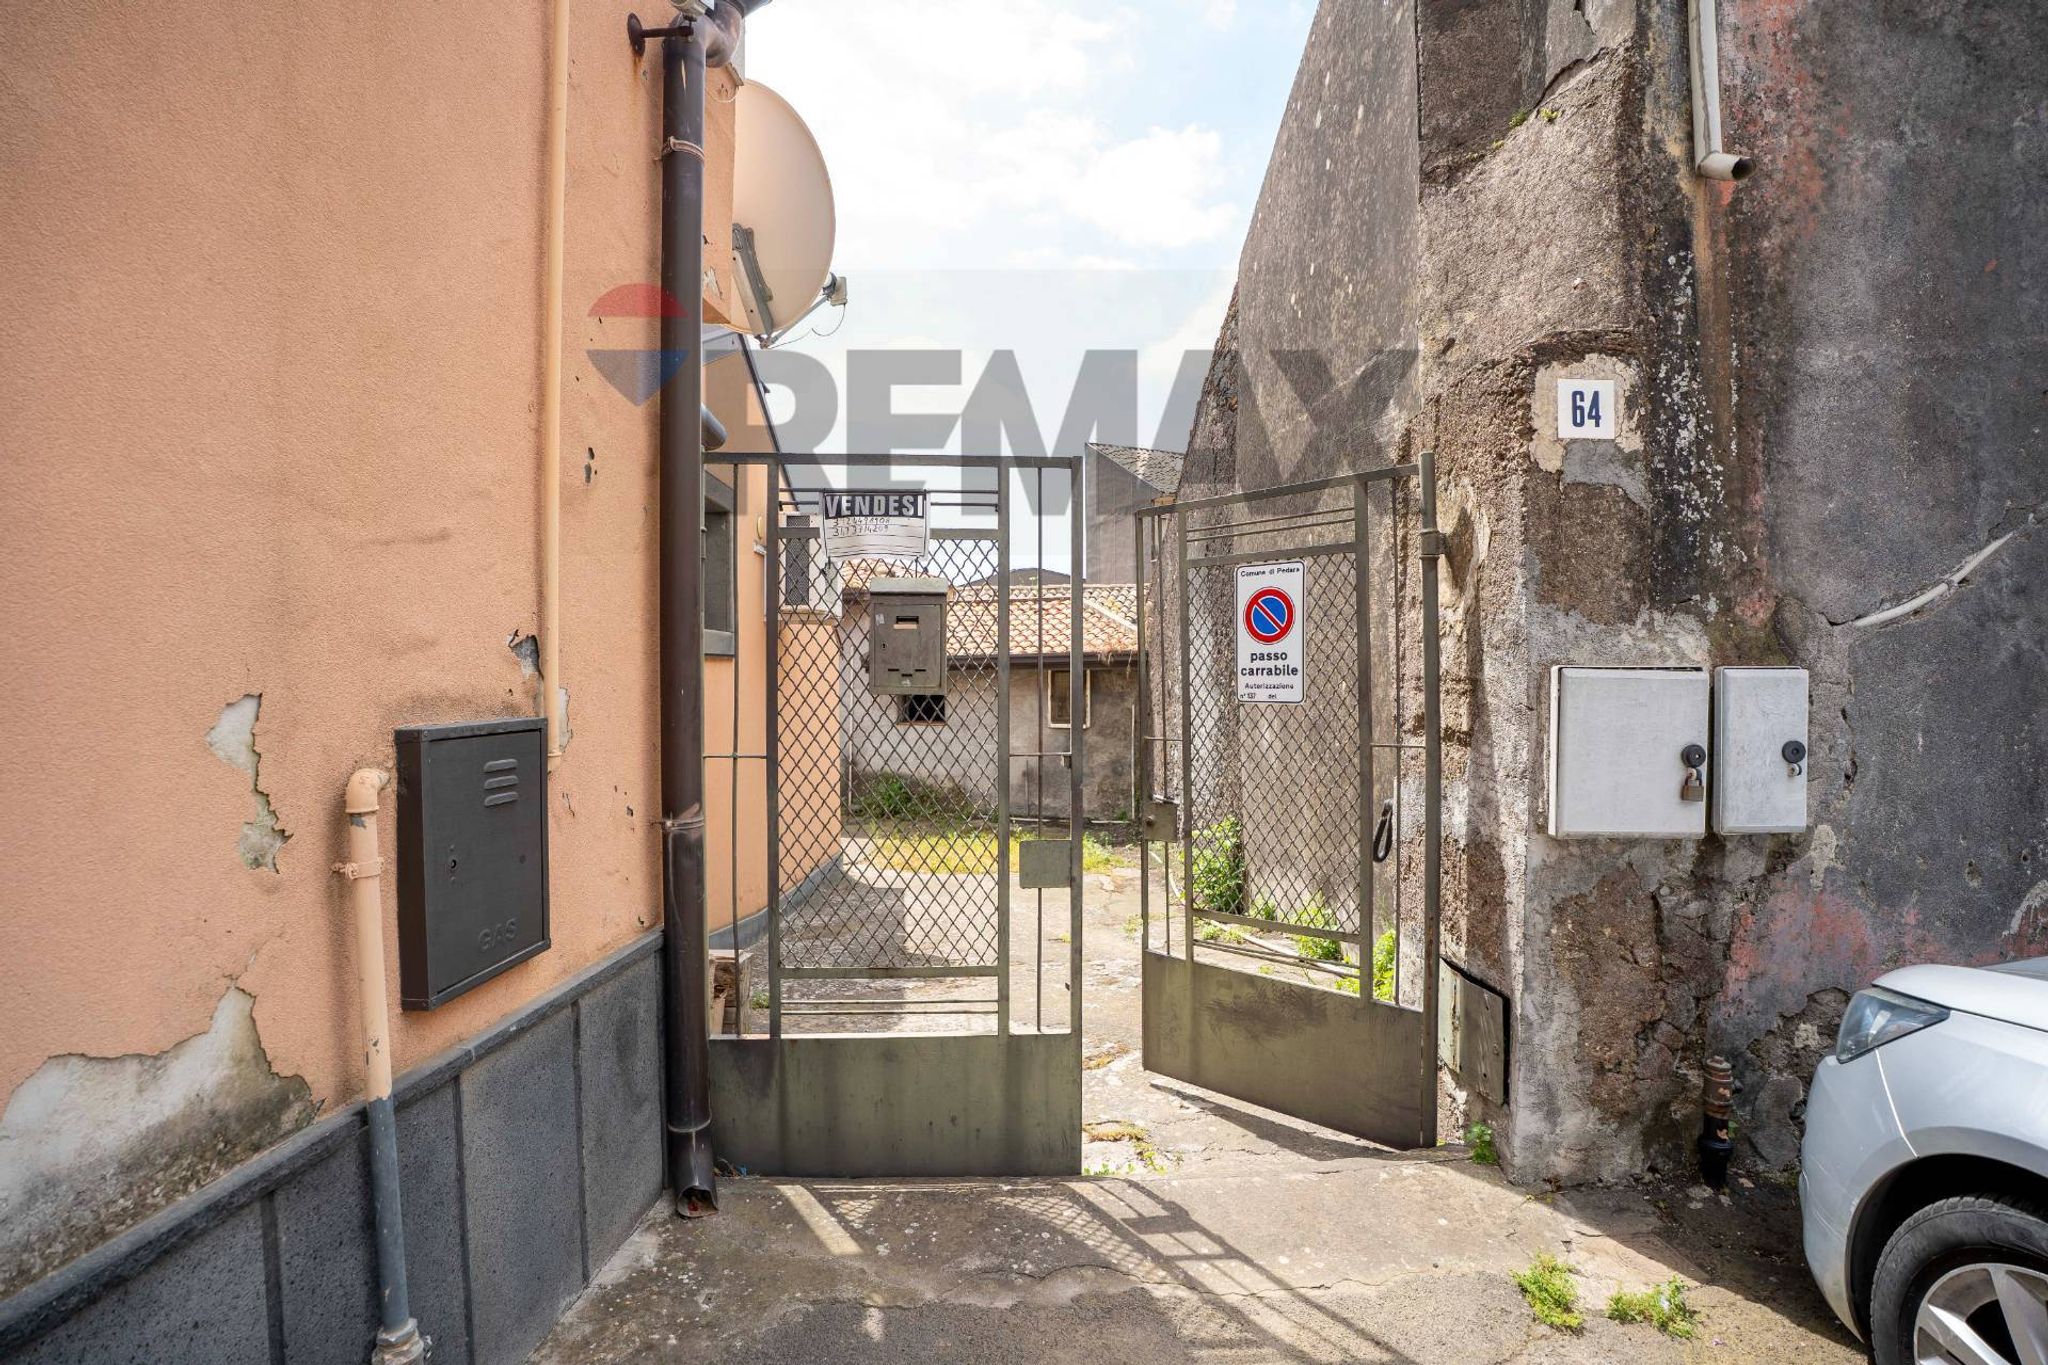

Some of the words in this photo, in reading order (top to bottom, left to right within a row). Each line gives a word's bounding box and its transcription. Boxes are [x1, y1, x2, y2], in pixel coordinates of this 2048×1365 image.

[1571, 390, 1602, 428] 64
[825, 495, 923, 517] VENDESI
[1240, 569, 1266, 577] Comune
[1268, 567, 1275, 576] di
[1277, 566, 1300, 575] Pedara
[1250, 652, 1288, 663] passo
[1240, 664, 1299, 677] carrabile
[1245, 682, 1294, 690] Autorizzazione
[478, 917, 518, 950] GAS
